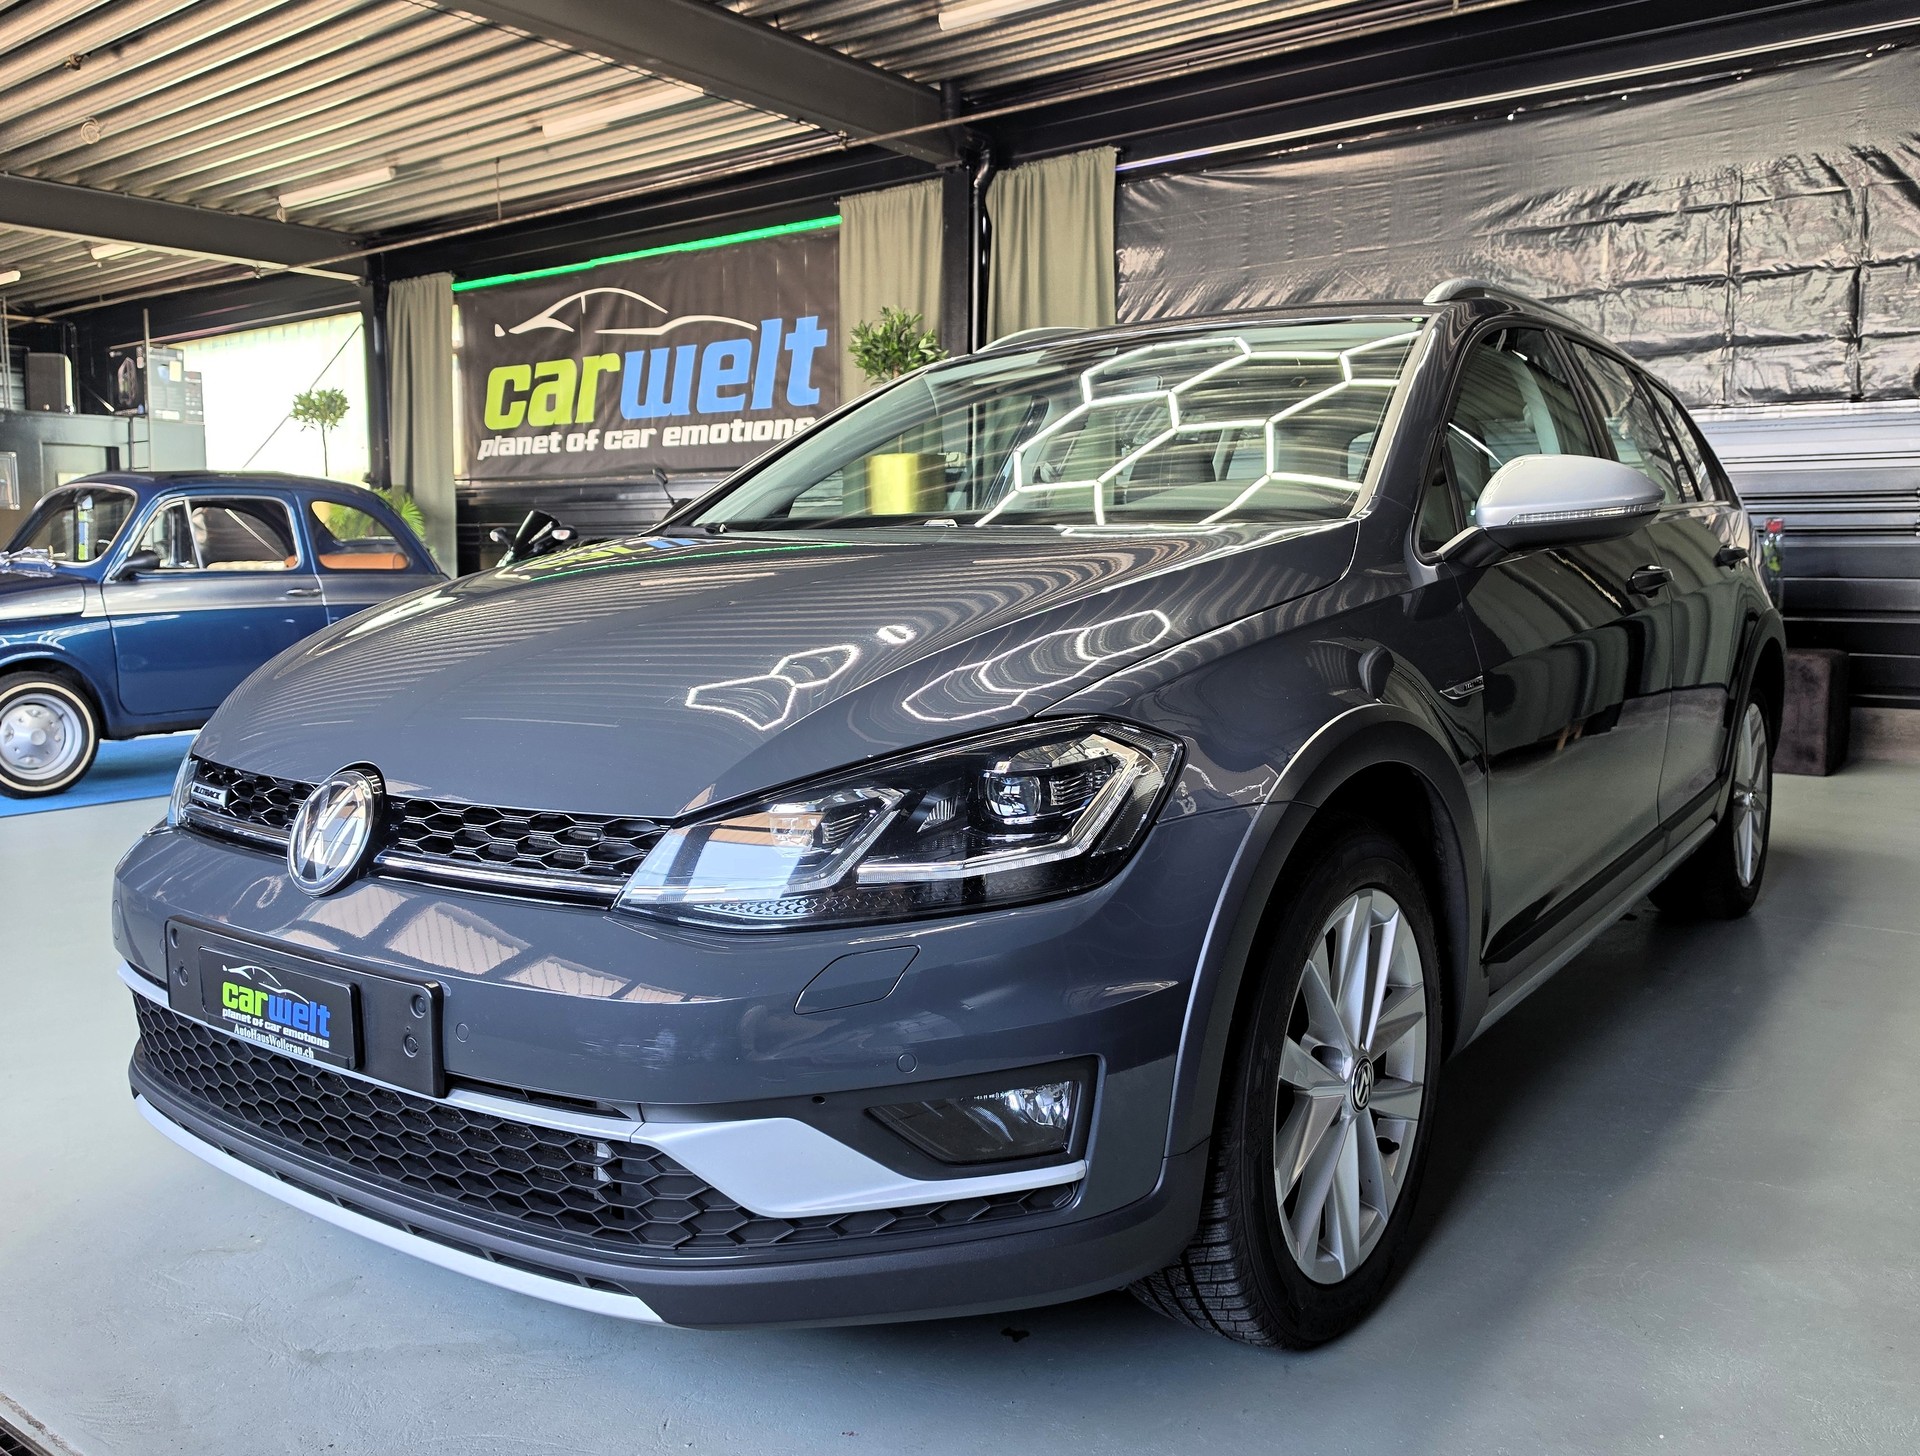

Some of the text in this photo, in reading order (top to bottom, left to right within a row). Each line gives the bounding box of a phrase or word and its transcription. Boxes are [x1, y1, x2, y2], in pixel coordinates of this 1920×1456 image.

[483, 315, 828, 431] carwelt
[476, 431, 563, 461] planet
[565, 428, 601, 453] of
[603, 427, 658, 451] car
[222, 981, 331, 1038] carwelt
[222, 1008, 330, 1049] planet of car emotions
[233, 1023, 315, 1060] AutoHausWollerau.ch
